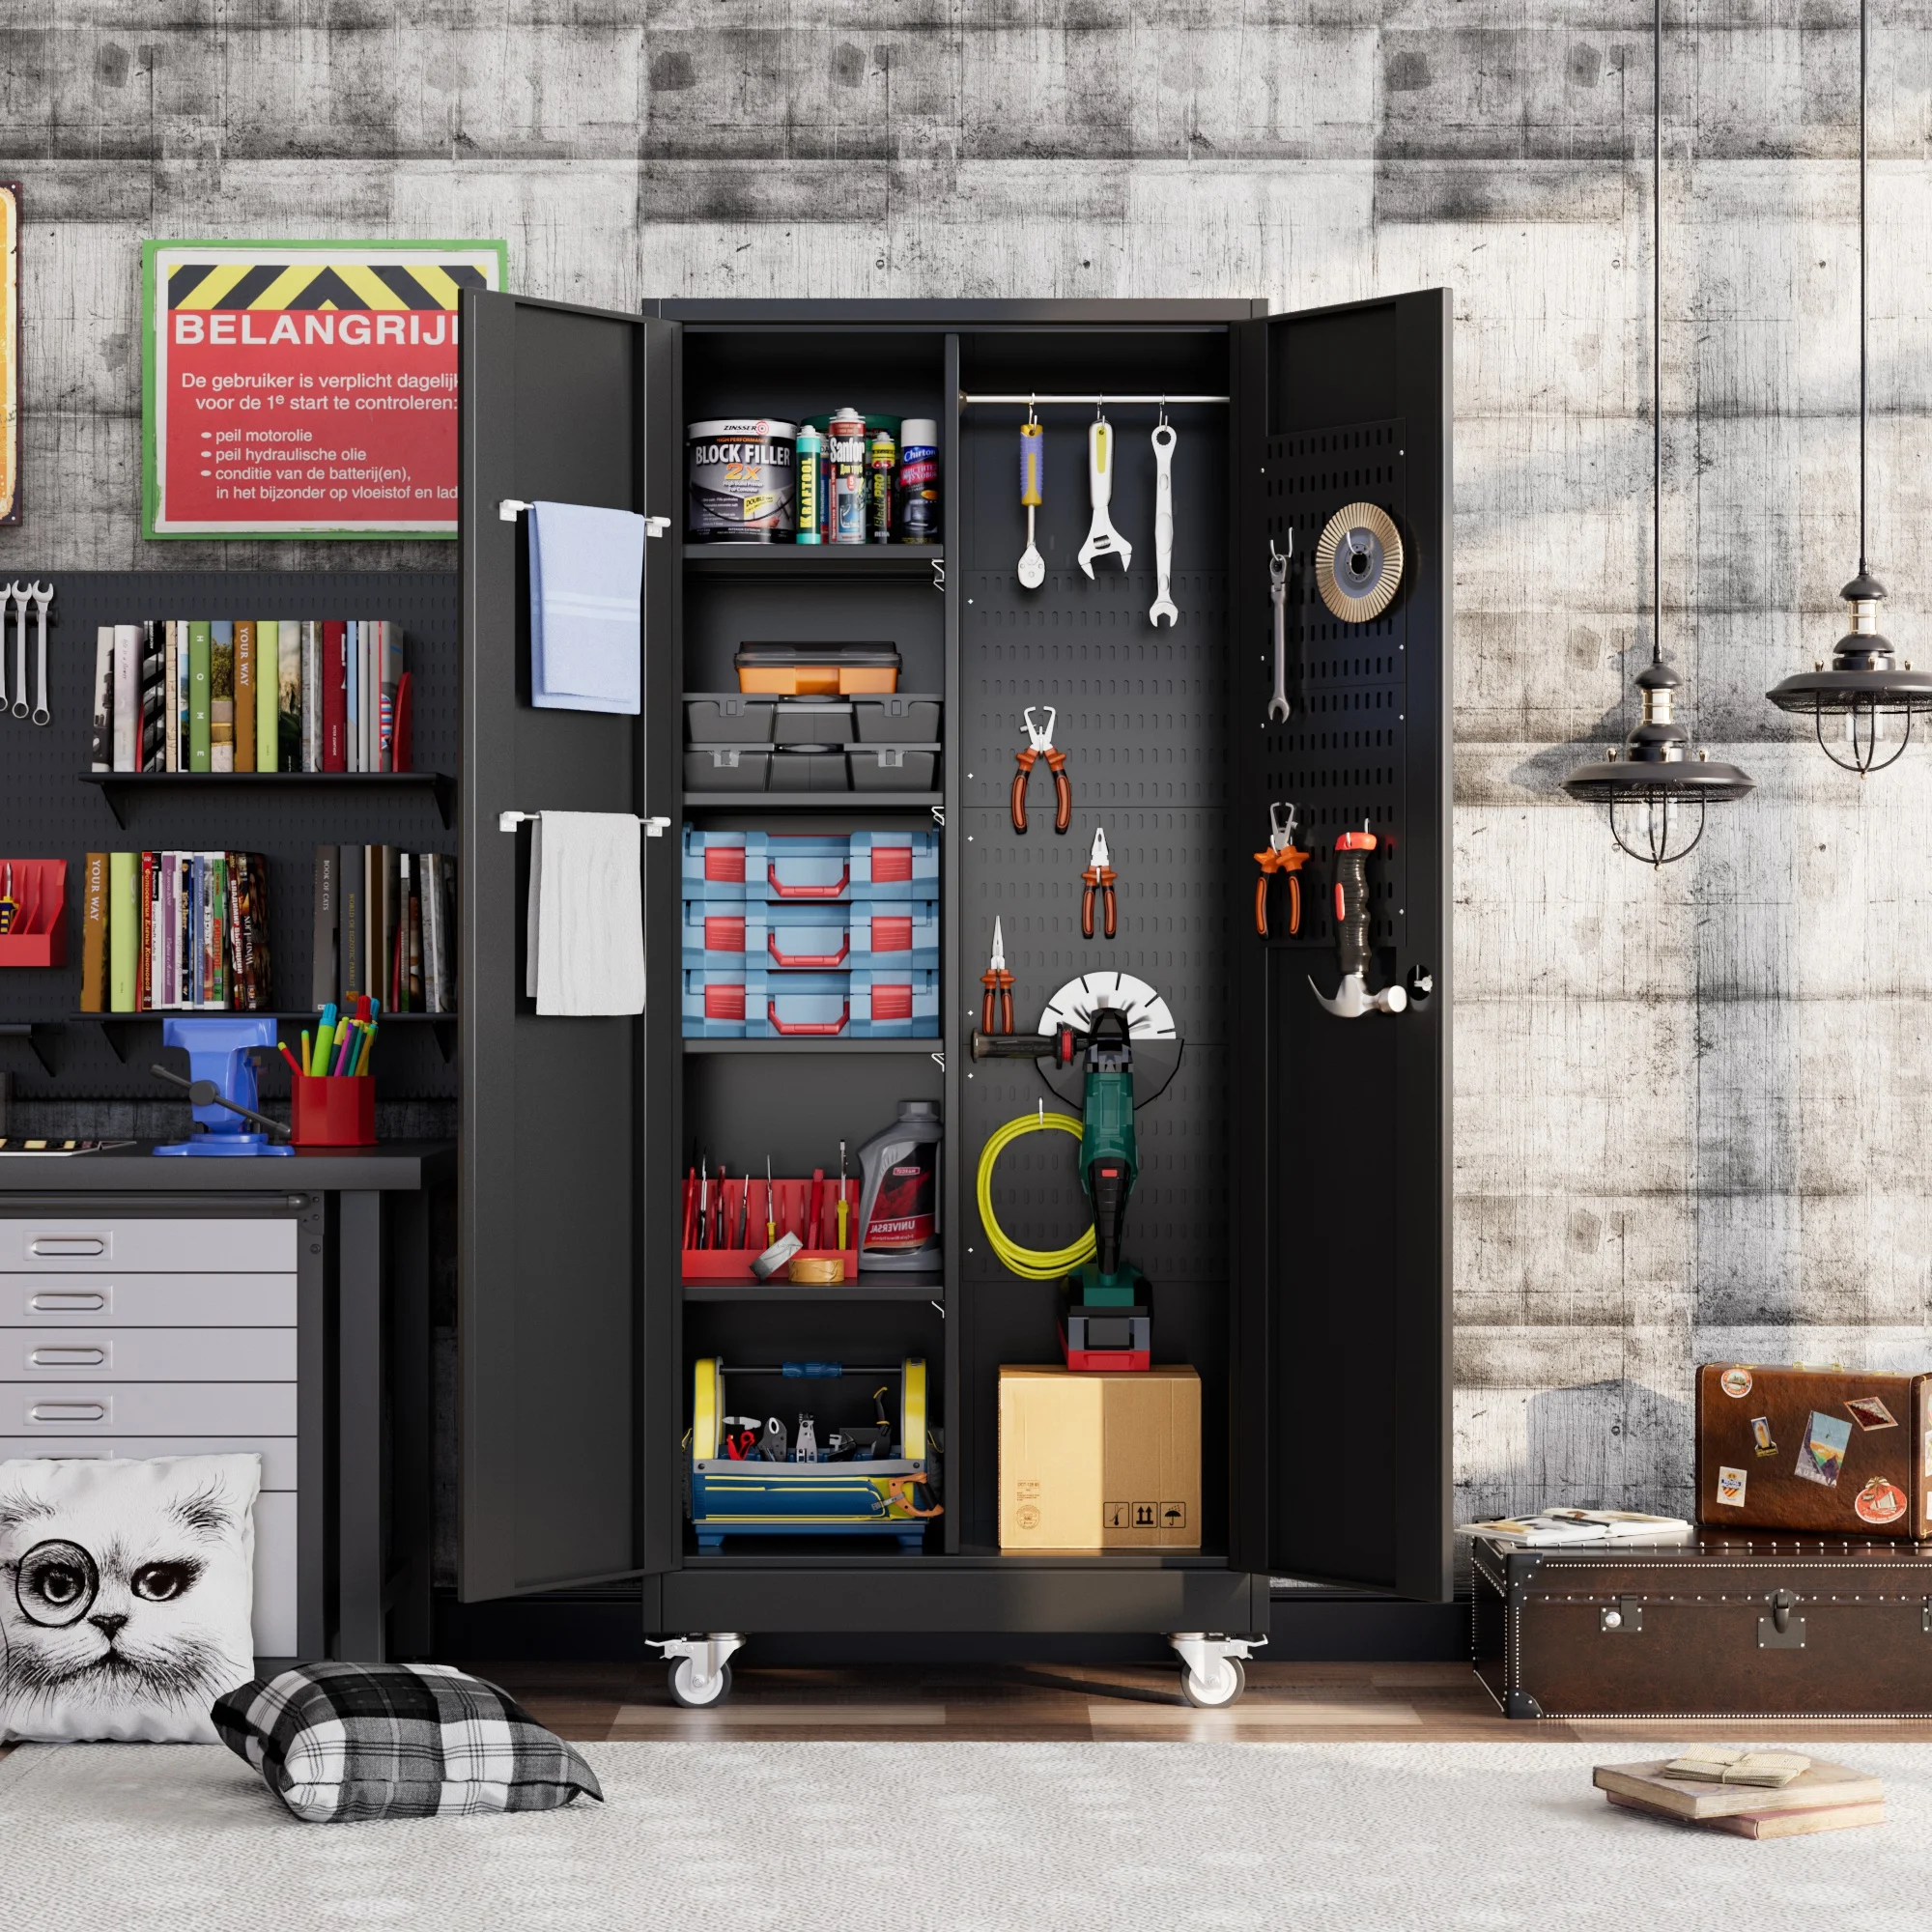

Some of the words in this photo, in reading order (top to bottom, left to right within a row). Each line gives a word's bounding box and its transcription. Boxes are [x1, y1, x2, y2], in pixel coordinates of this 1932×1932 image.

[175, 314, 459, 346] BELANGRIJ
[182, 372, 207, 388] De
[212, 372, 295, 392] gebruiker
[298, 372, 314, 388] is
[318, 372, 392, 392] verplicht
[195, 397, 235, 411] voor
[239, 394, 262, 411] de
[289, 395, 328, 411] start
[333, 395, 351, 411] te
[355, 394, 458, 411] controleren:
[215, 428, 242, 445] peil
[245, 428, 313, 442] motorolie
[215, 447, 242, 464] peil
[245, 447, 337, 464] hydraulische
[340, 447, 367, 461] olie
[696, 443, 742, 466] BLOCK
[744, 443, 790, 467] FILLER
[830, 437, 866, 463] Sanfor
[904, 448, 937, 462] Chirton
[214, 467, 272, 480] conditie
[275, 469, 302, 480] van
[306, 467, 326, 480] de
[329, 467, 412, 483] batterij(en),
[839, 464, 851, 475] Для
[216, 486, 229, 499] in
[233, 486, 256, 499] het
[260, 486, 327, 502] bijzonder
[329, 488, 348, 502] op
[352, 486, 412, 499] vloeistof
[414, 488, 433, 499] en
[800, 457, 812, 528] KRAFTOOL
[240, 627, 249, 659] YOUR
[240, 662, 249, 686] WAY
[92, 859, 101, 893] YOUR
[323, 881, 329, 892] OF
[90, 896, 100, 921] WAY
[231, 880, 240, 926] ВЛАДИМИР
[349, 919, 355, 929] OF
[213, 918, 222, 970] ЖИВОТНОЕ
[234, 927, 243, 974] ВЫСОЦКИЙ
